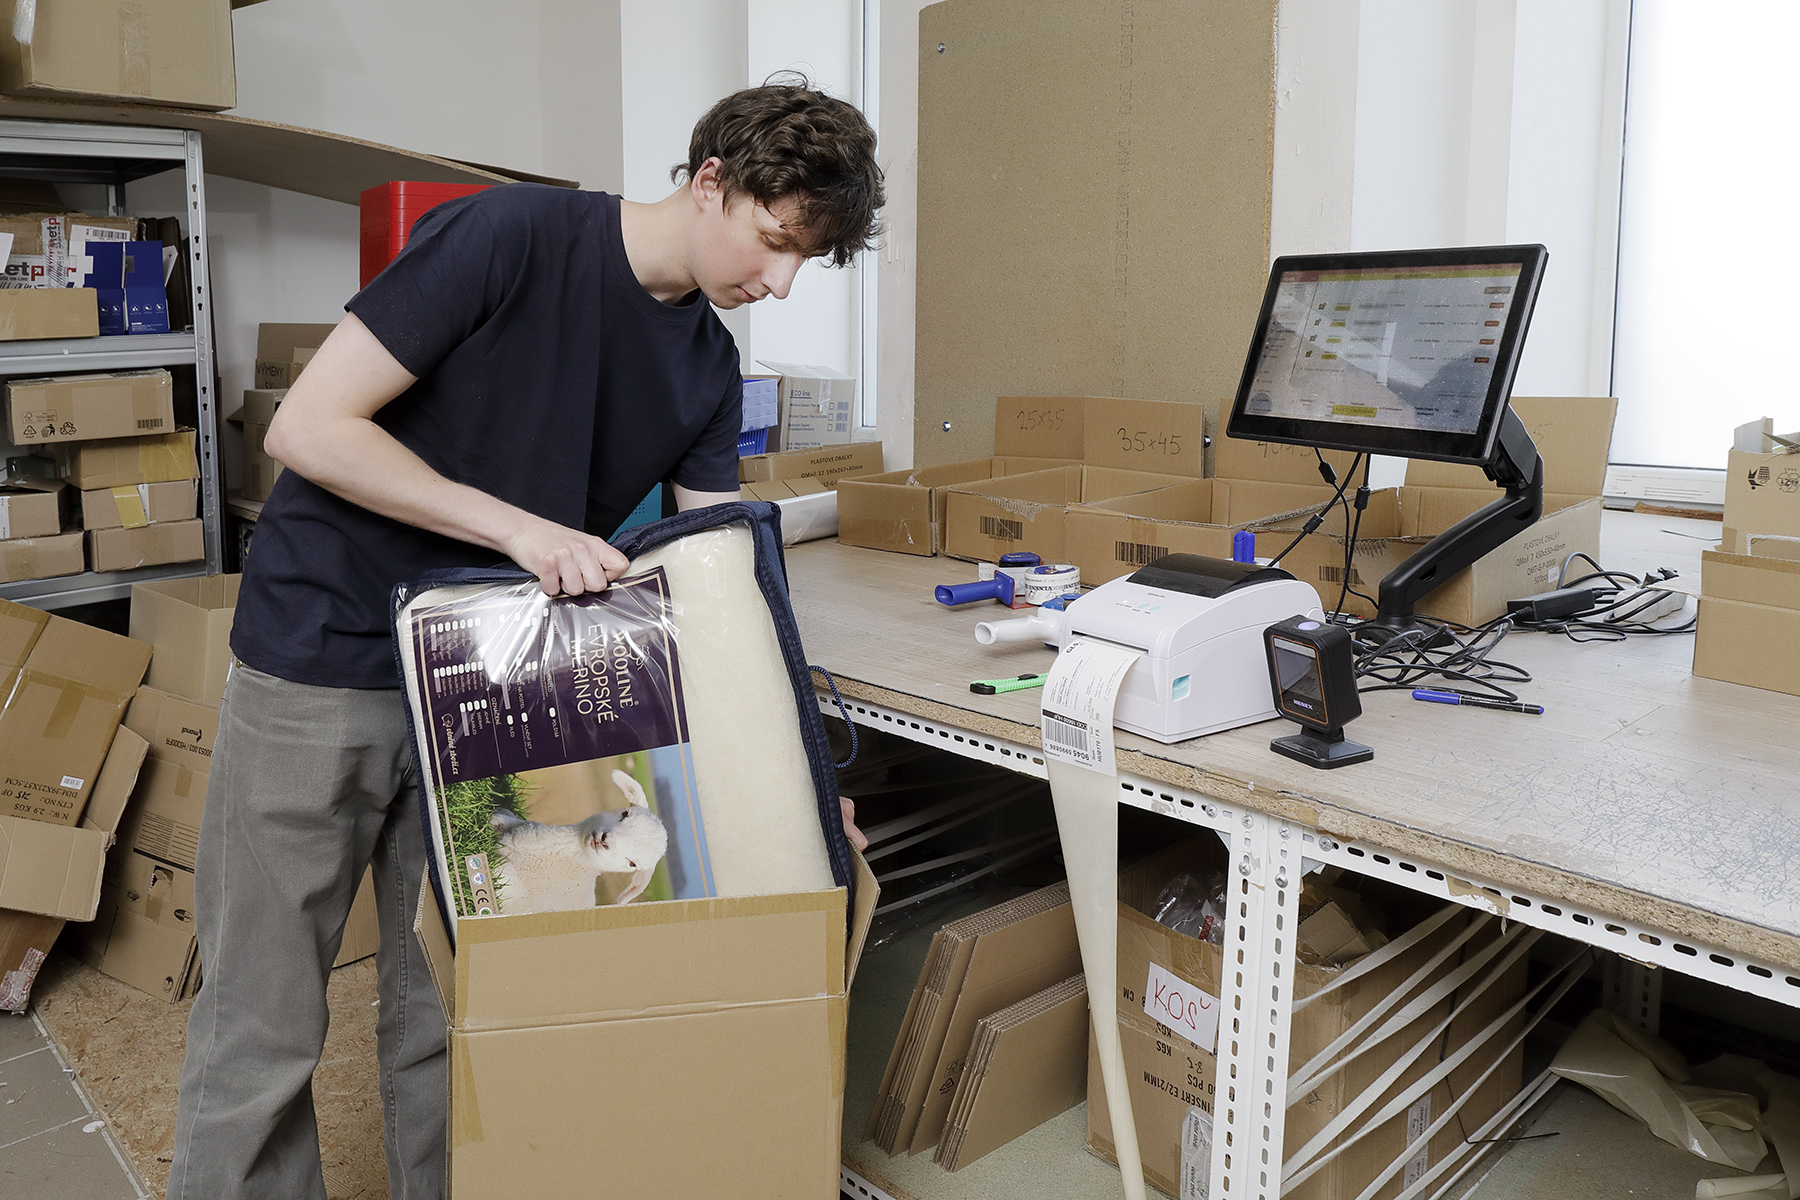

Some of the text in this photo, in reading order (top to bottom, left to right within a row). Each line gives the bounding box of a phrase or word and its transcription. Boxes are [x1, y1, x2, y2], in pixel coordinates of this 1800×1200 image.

[570, 638, 594, 715] MERINO
[588, 623, 619, 724] EVROPSKÉ
[13, 802, 32, 812] KGS
[1123, 987, 1135, 1002] CM
[1156, 1040, 1173, 1057] KGS
[1187, 1074, 1204, 1091] PCS
